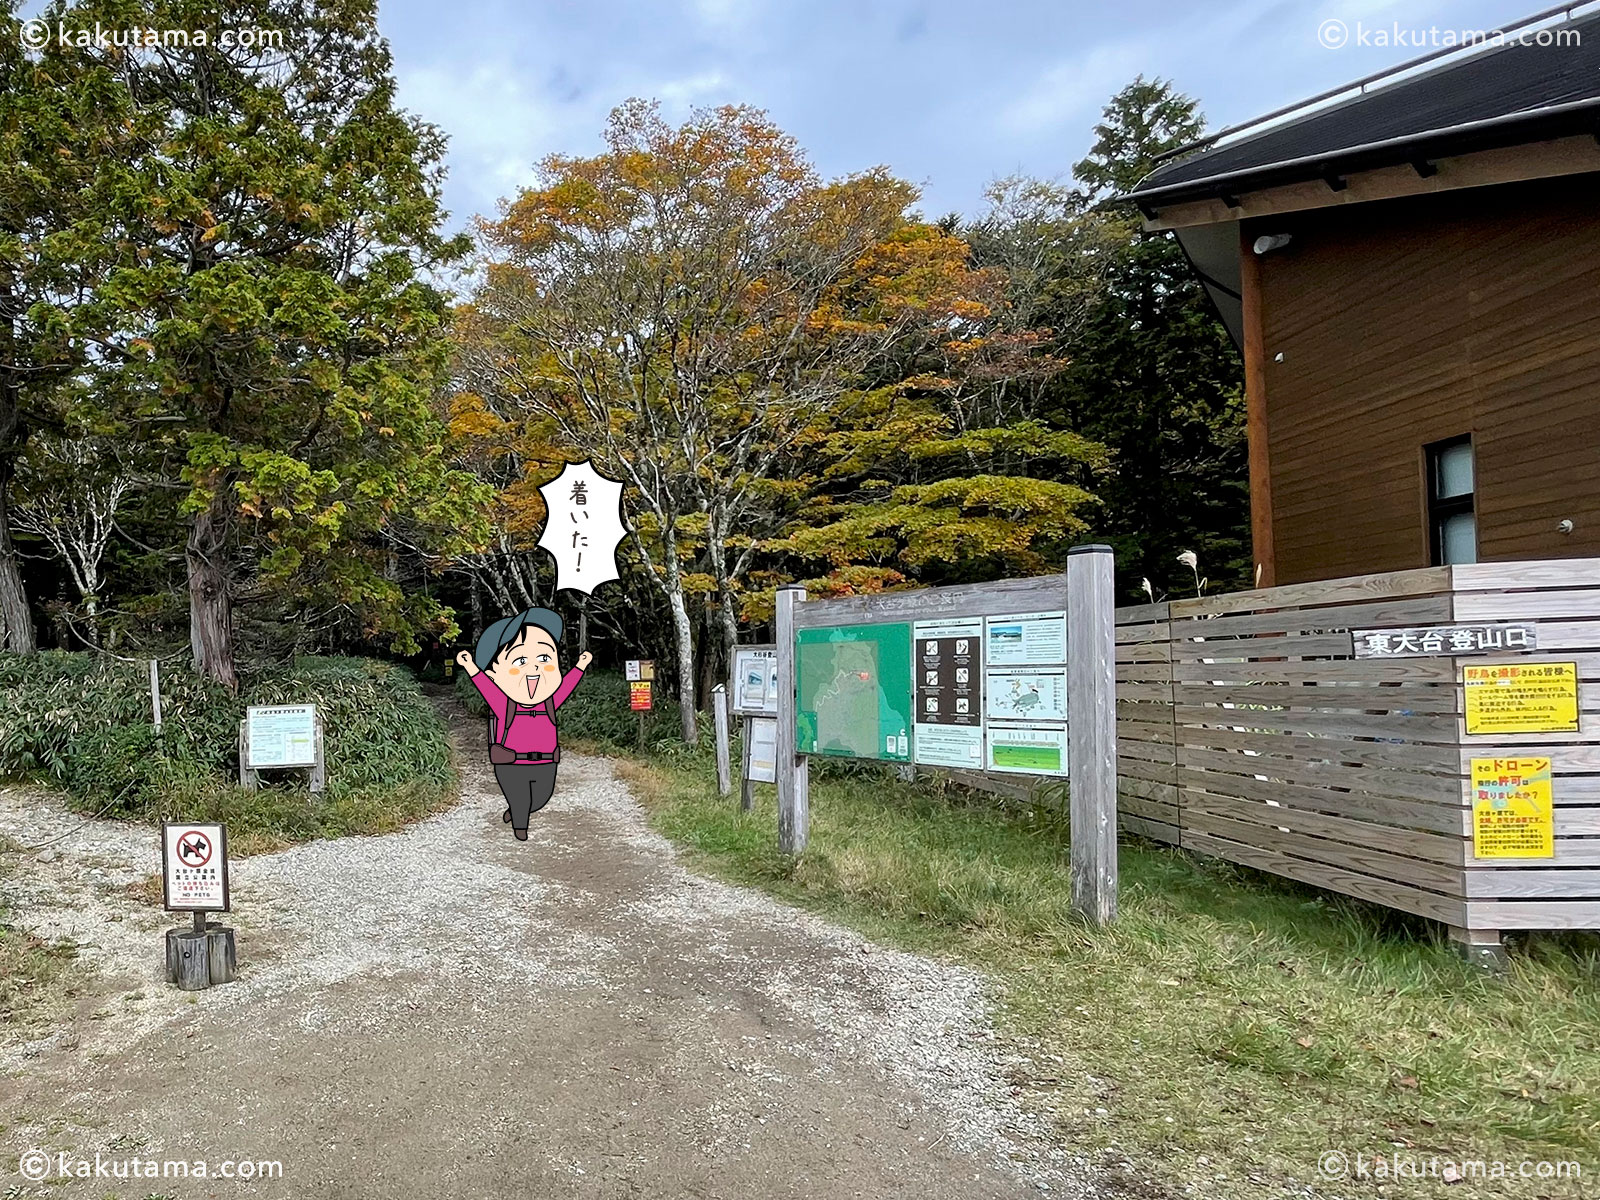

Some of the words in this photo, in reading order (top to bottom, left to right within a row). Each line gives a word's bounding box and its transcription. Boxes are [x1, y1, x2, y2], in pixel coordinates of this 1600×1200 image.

[1366, 627, 1527, 654] 東大台登山口
[1467, 667, 1573, 679] 野鳥を撮影される皆様へ
[1477, 760, 1548, 772] そのドローン
